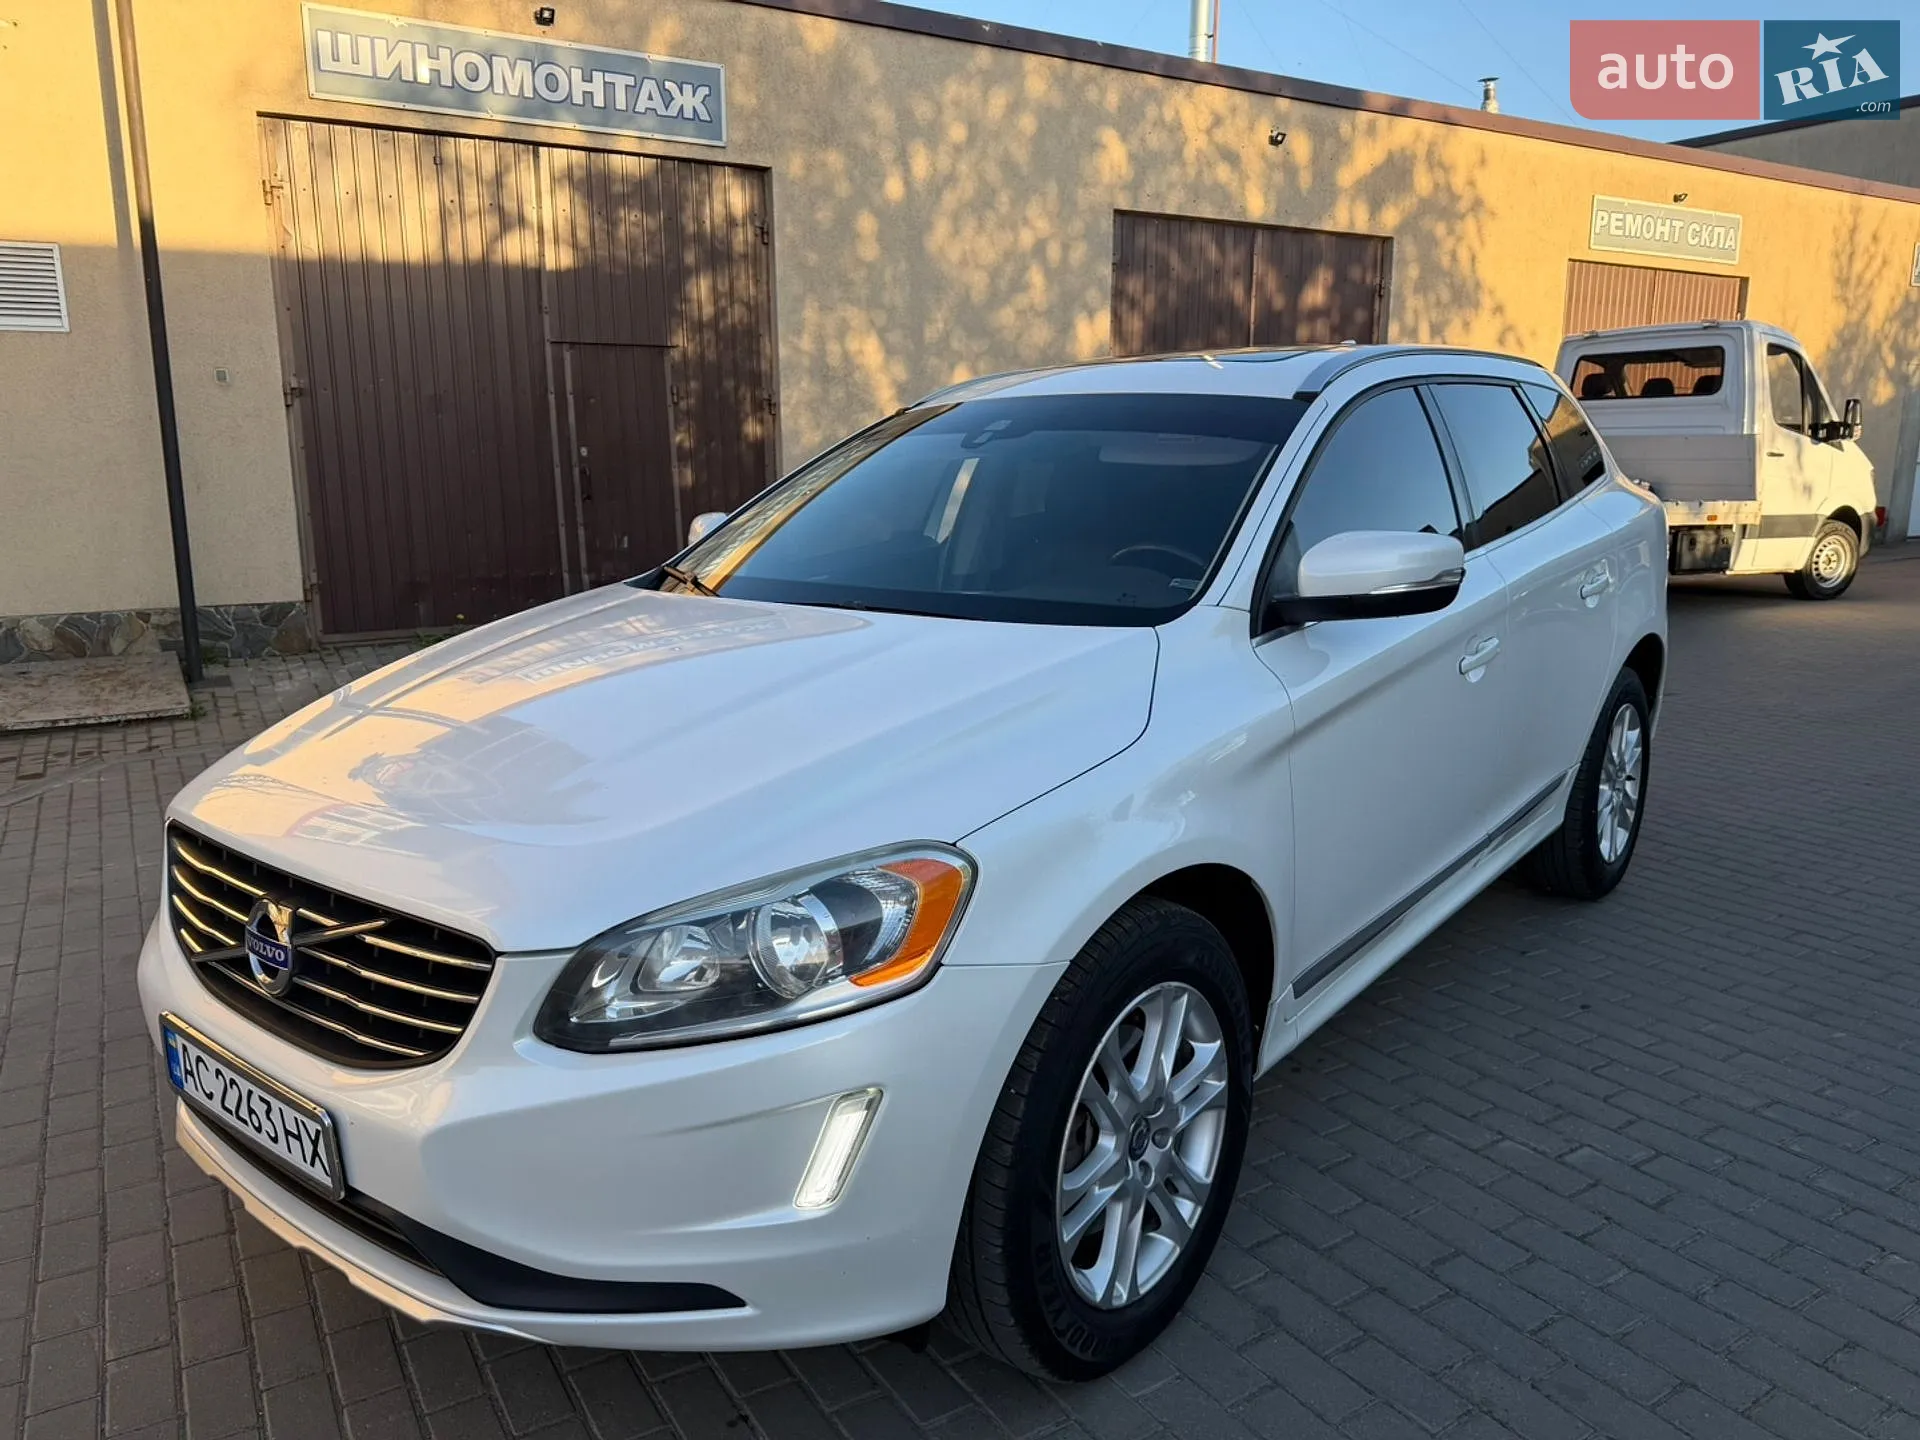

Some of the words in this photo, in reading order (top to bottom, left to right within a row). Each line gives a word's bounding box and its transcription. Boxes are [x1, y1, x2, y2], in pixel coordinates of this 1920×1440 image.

[316, 30, 711, 122] ШИНОМОНТАЖ
[1595, 209, 1685, 244] РЕМОНТ
[1687, 221, 1737, 251] СКЛА
[246, 934, 286, 962] VOLVO
